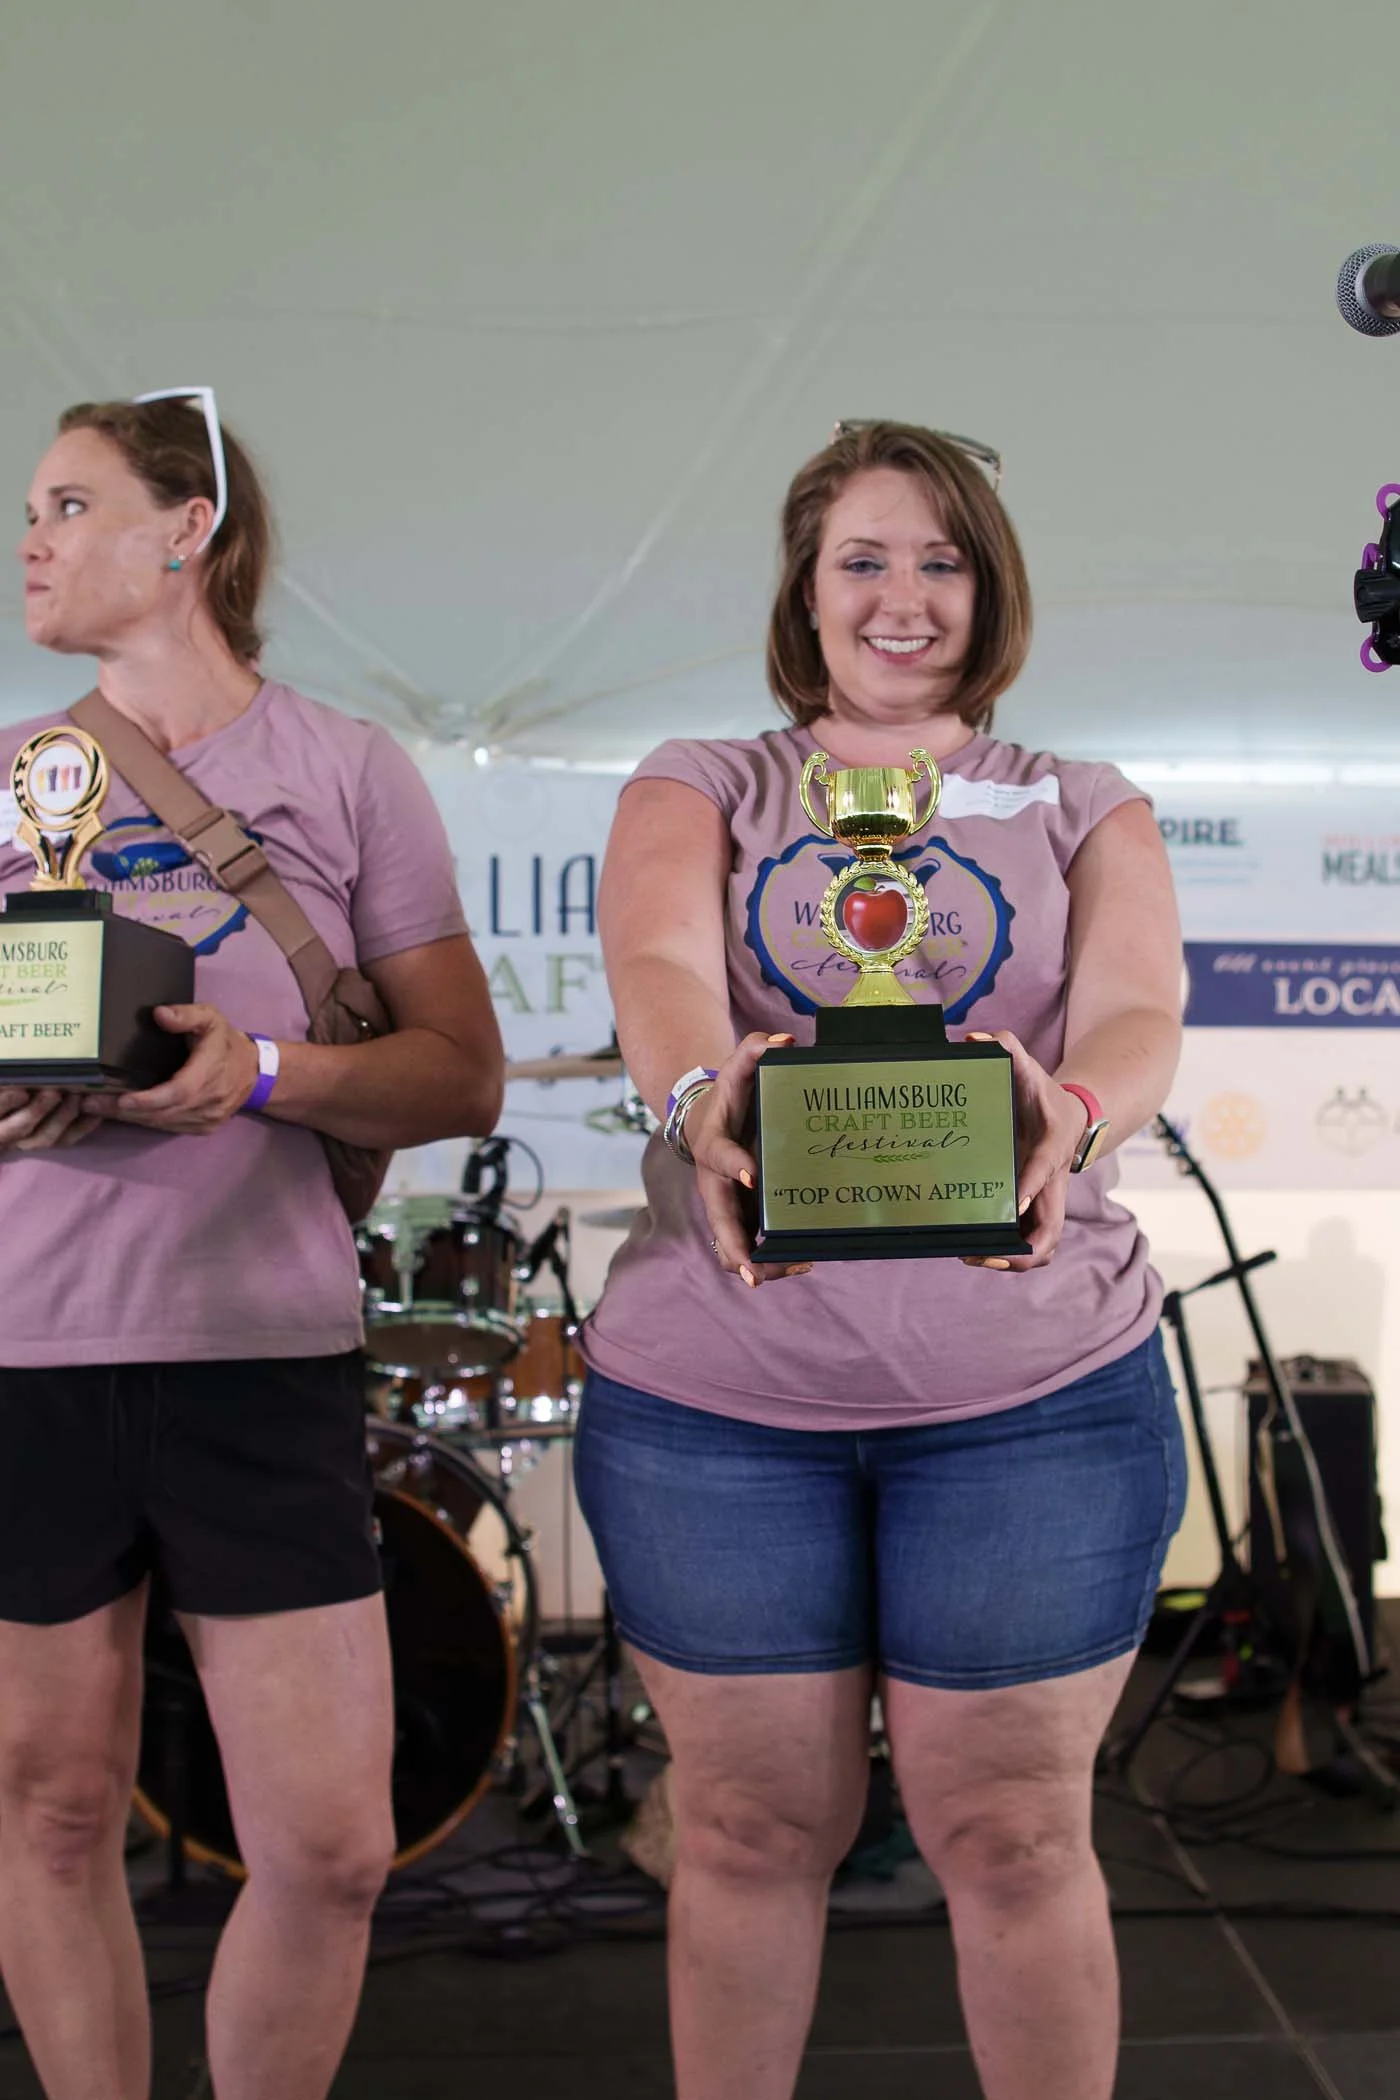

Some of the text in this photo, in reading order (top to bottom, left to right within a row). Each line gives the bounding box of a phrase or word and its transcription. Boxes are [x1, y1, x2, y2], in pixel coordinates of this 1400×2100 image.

[472, 853, 596, 936] LIA
[17, 963, 67, 978] BEER
[1273, 977, 1400, 1016] LOCA
[803, 1083, 967, 1111] WILLIAMSBURG
[805, 1111, 968, 1133] CRAFT BEER
[808, 1130, 970, 1158] festival
[774, 1181, 1004, 1205] “TOP CROWN APPLE”
